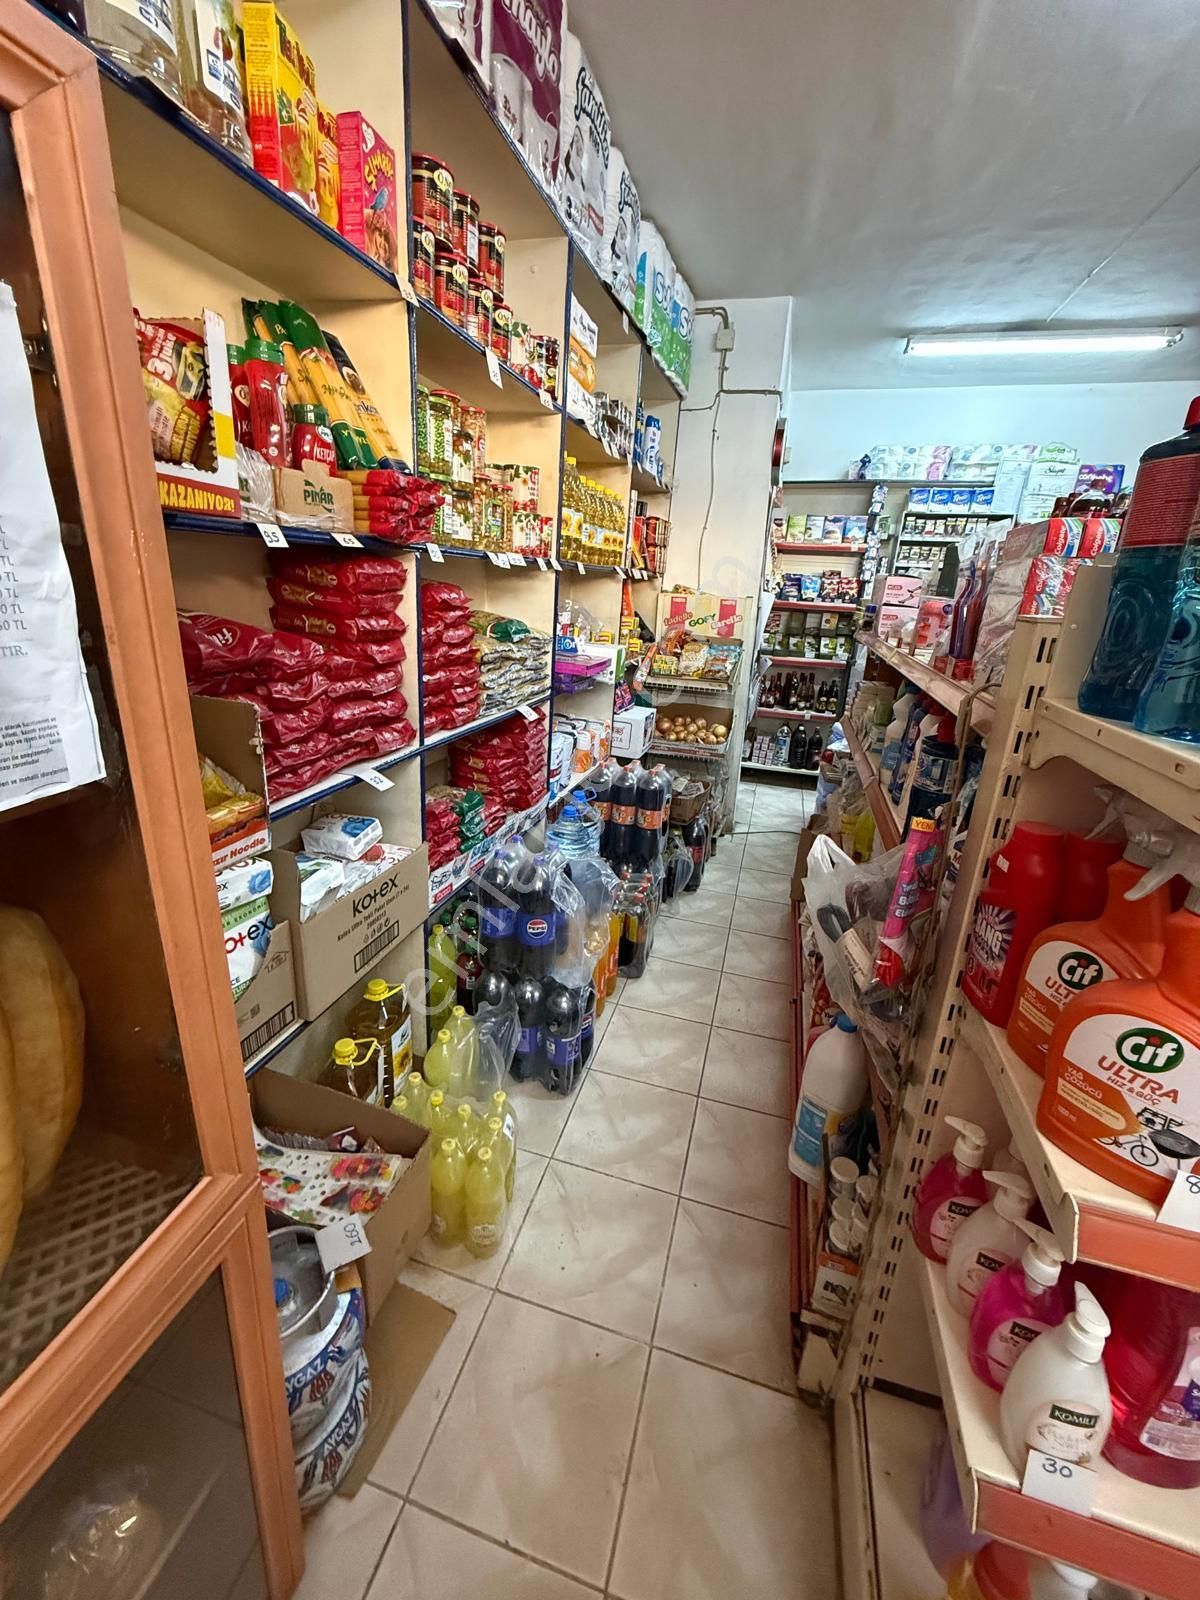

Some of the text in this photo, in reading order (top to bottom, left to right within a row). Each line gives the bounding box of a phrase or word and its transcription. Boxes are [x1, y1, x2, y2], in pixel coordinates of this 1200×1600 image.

[262, 530, 280, 544] 95
[1054, 526, 1067, 556] Colgate
[1090, 527, 1103, 556] Colgate
[10, 603, 25, 614] TL
[15, 619, 28, 630] TL
[230, 836, 266, 858] Noodle
[353, 872, 400, 918] kotex
[1060, 958, 1100, 986] Cif
[1044, 976, 1076, 1000] ULT
[1120, 1035, 1178, 1068] Cif
[1067, 1065, 1084, 1081] YAĞ
[1097, 1055, 1181, 1105] ULTRA
[1106, 1076, 1126, 1091] HIZ
[1135, 1090, 1161, 1106] GÜÇ
[286, 1358, 325, 1393] YGAZ
[1042, 1457, 1073, 1478] 30
